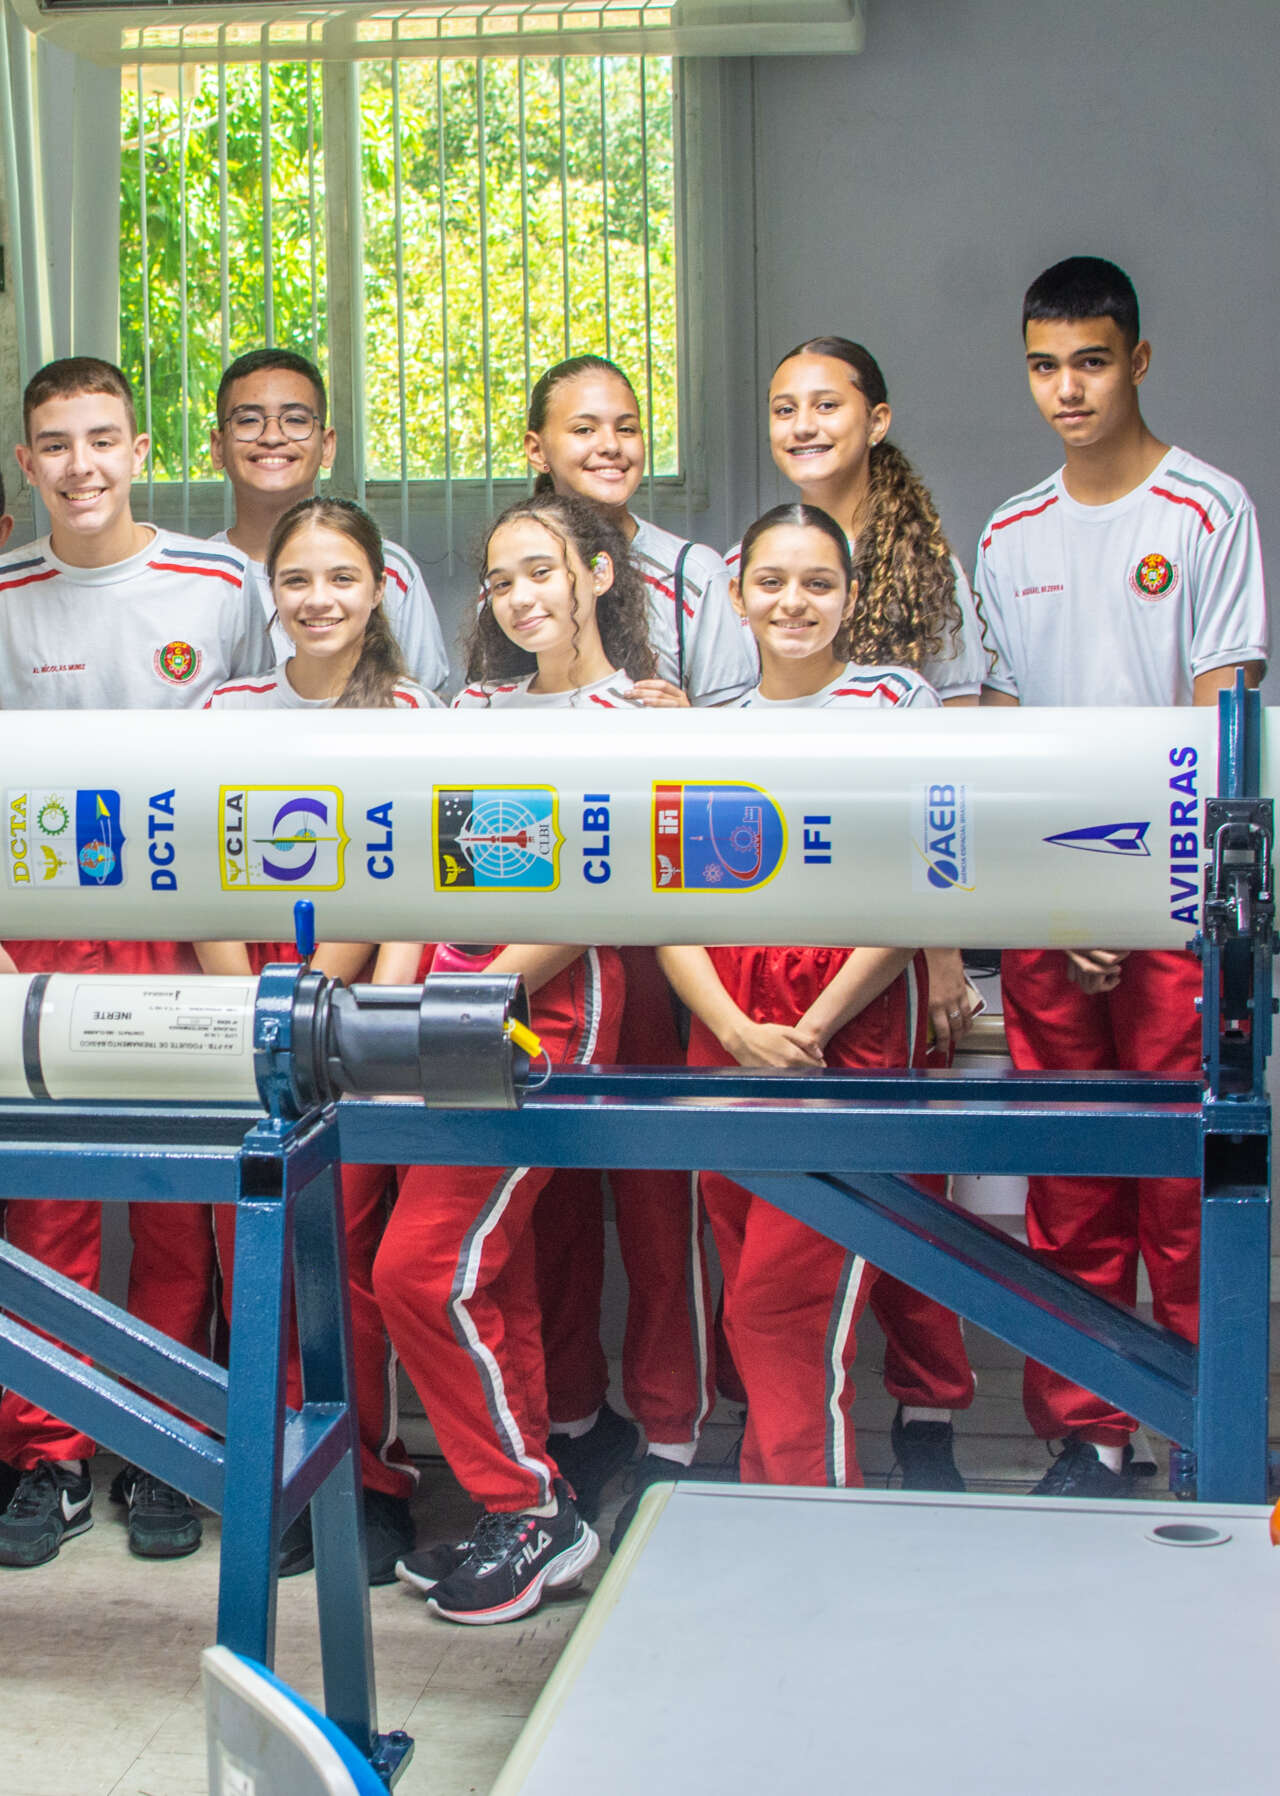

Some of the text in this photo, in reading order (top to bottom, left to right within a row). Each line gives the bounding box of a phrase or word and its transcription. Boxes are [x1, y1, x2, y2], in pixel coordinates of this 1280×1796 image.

[10, 794, 32, 884] DCTA
[148, 788, 178, 891] DCTA
[226, 793, 244, 857] CLA
[366, 800, 395, 880] CLA
[538, 822, 550, 856] CLBI
[582, 793, 611, 885] CLBI
[803, 815, 832, 865] IFI
[929, 784, 957, 860] AEB
[1169, 746, 1200, 925] AVIBRAS
[93, 1011, 132, 1021] INERTE
[158, 1041, 169, 1049] DE
[170, 1041, 204, 1050] FOGUETE
[514, 1529, 553, 1576] FILA
